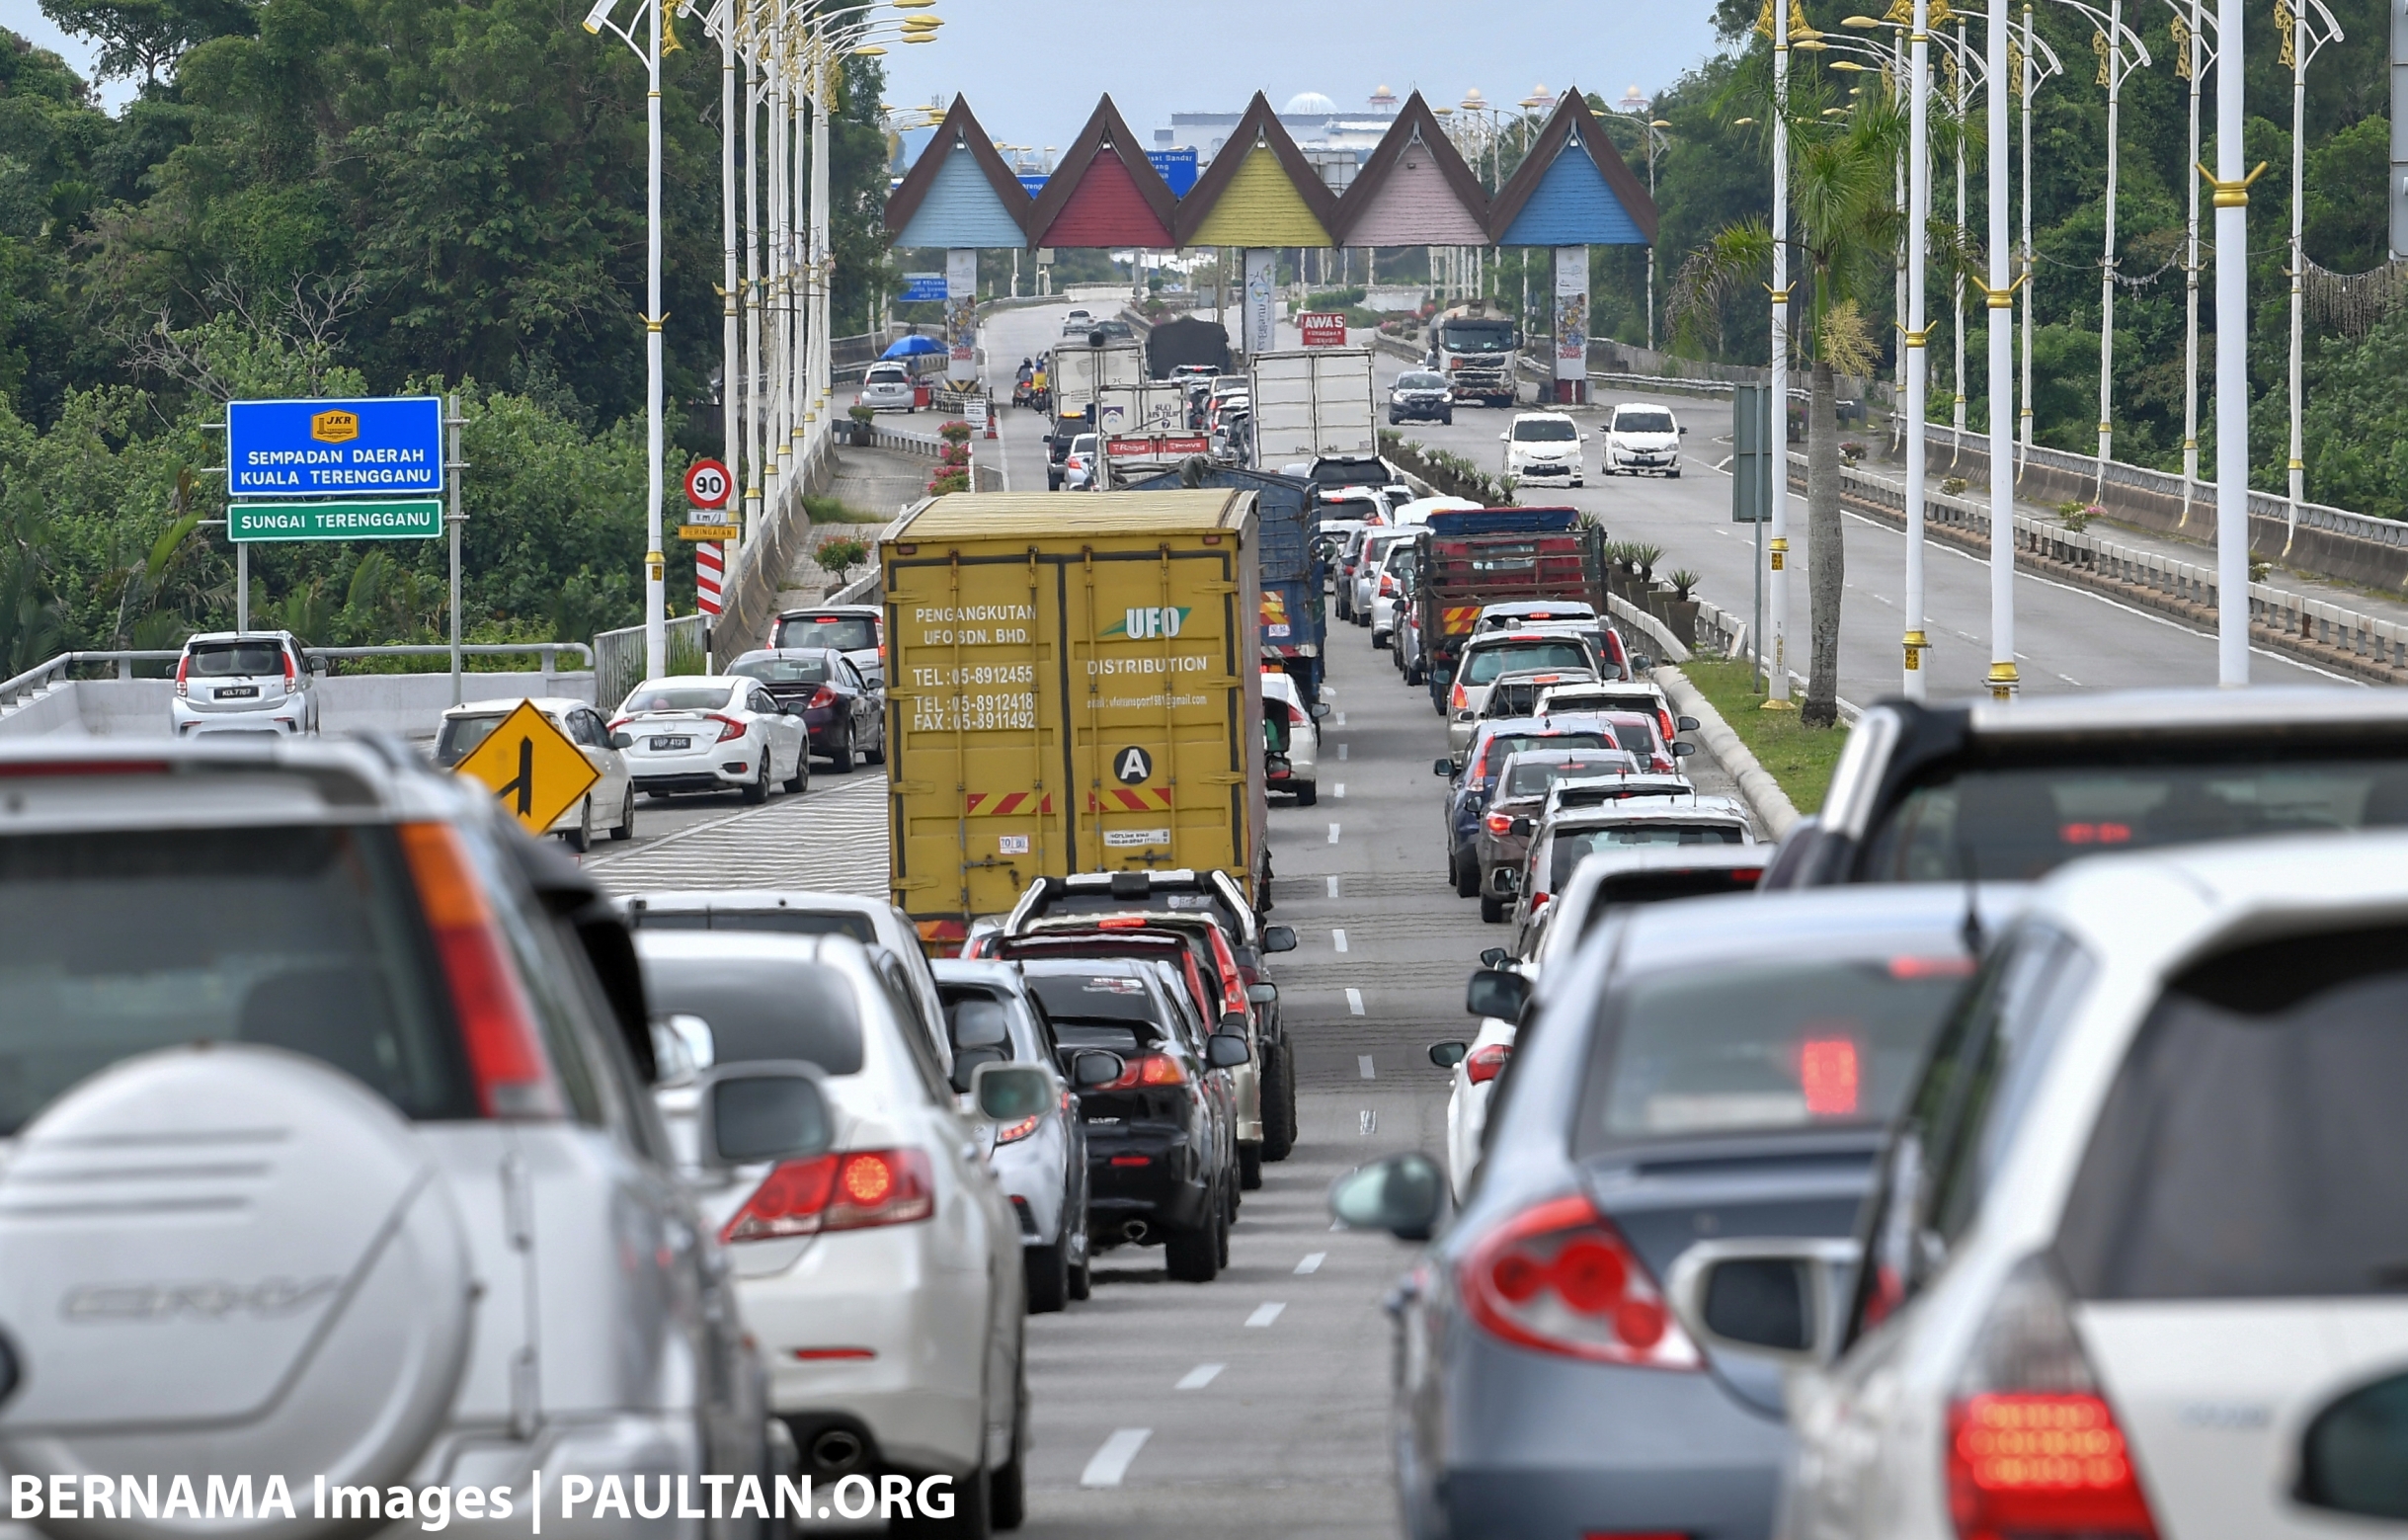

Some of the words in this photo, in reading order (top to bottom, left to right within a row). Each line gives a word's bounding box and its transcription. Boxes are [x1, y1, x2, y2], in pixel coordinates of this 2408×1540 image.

[1305, 315, 1343, 329] AWAS
[327, 416, 352, 425] JKR
[248, 449, 343, 465] SEMPADAN
[353, 448, 424, 463] DAERAH
[240, 470, 299, 485] KUALA
[310, 468, 432, 484] TERENGGANU
[695, 476, 722, 494] 90
[241, 515, 306, 529] SUNGAI
[315, 512, 431, 528] TERENGGANU
[916, 605, 1037, 622] PENGANGKUTAN
[1126, 607, 1180, 640] UFO
[923, 629, 954, 644] UFO
[958, 629, 992, 644] SDN.
[1087, 657, 1207, 675] DISTRIBUTION
[1120, 748, 1148, 779] A
